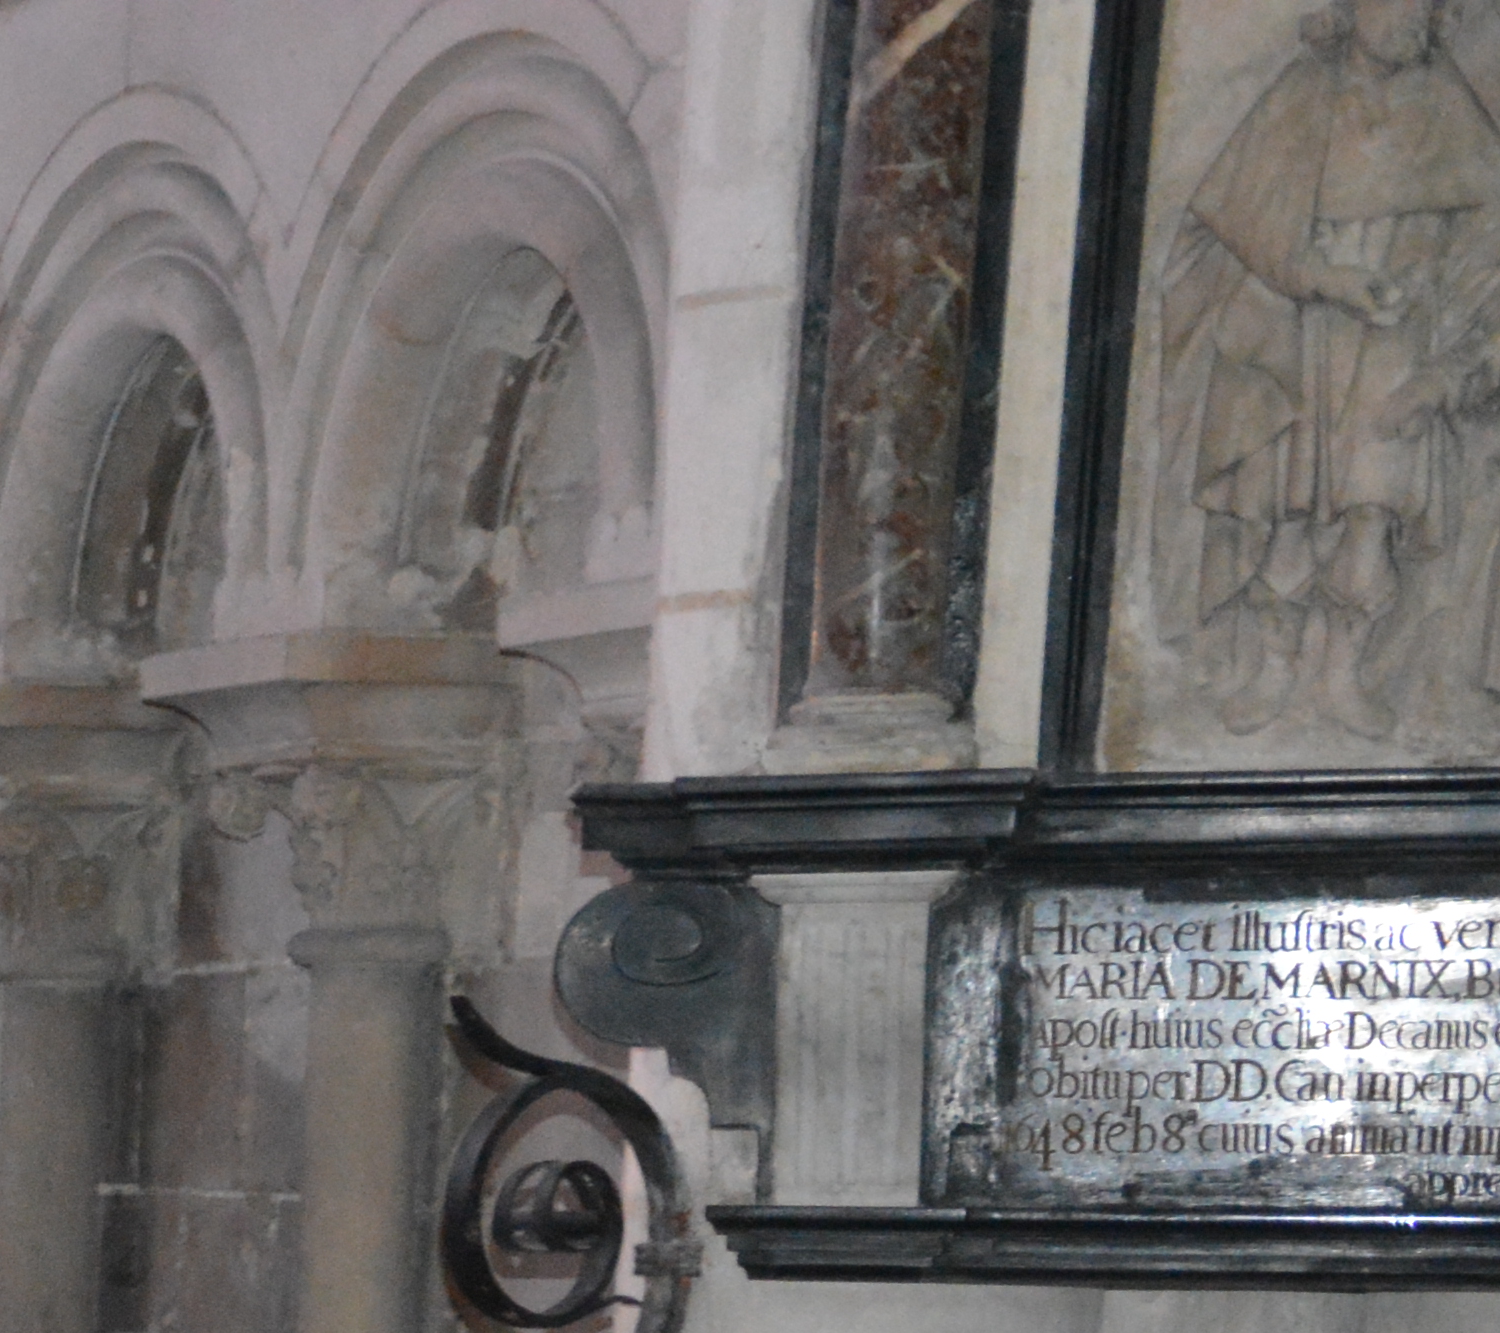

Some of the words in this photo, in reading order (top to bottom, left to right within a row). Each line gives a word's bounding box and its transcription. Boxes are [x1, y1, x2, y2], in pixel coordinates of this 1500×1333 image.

[1023, 897, 1108, 955] Hic
[1112, 904, 1219, 954] iacet
[1374, 919, 1422, 951] ac
[1033, 960, 1176, 1000] MARIA
[1129, 1007, 1224, 1049] huius
